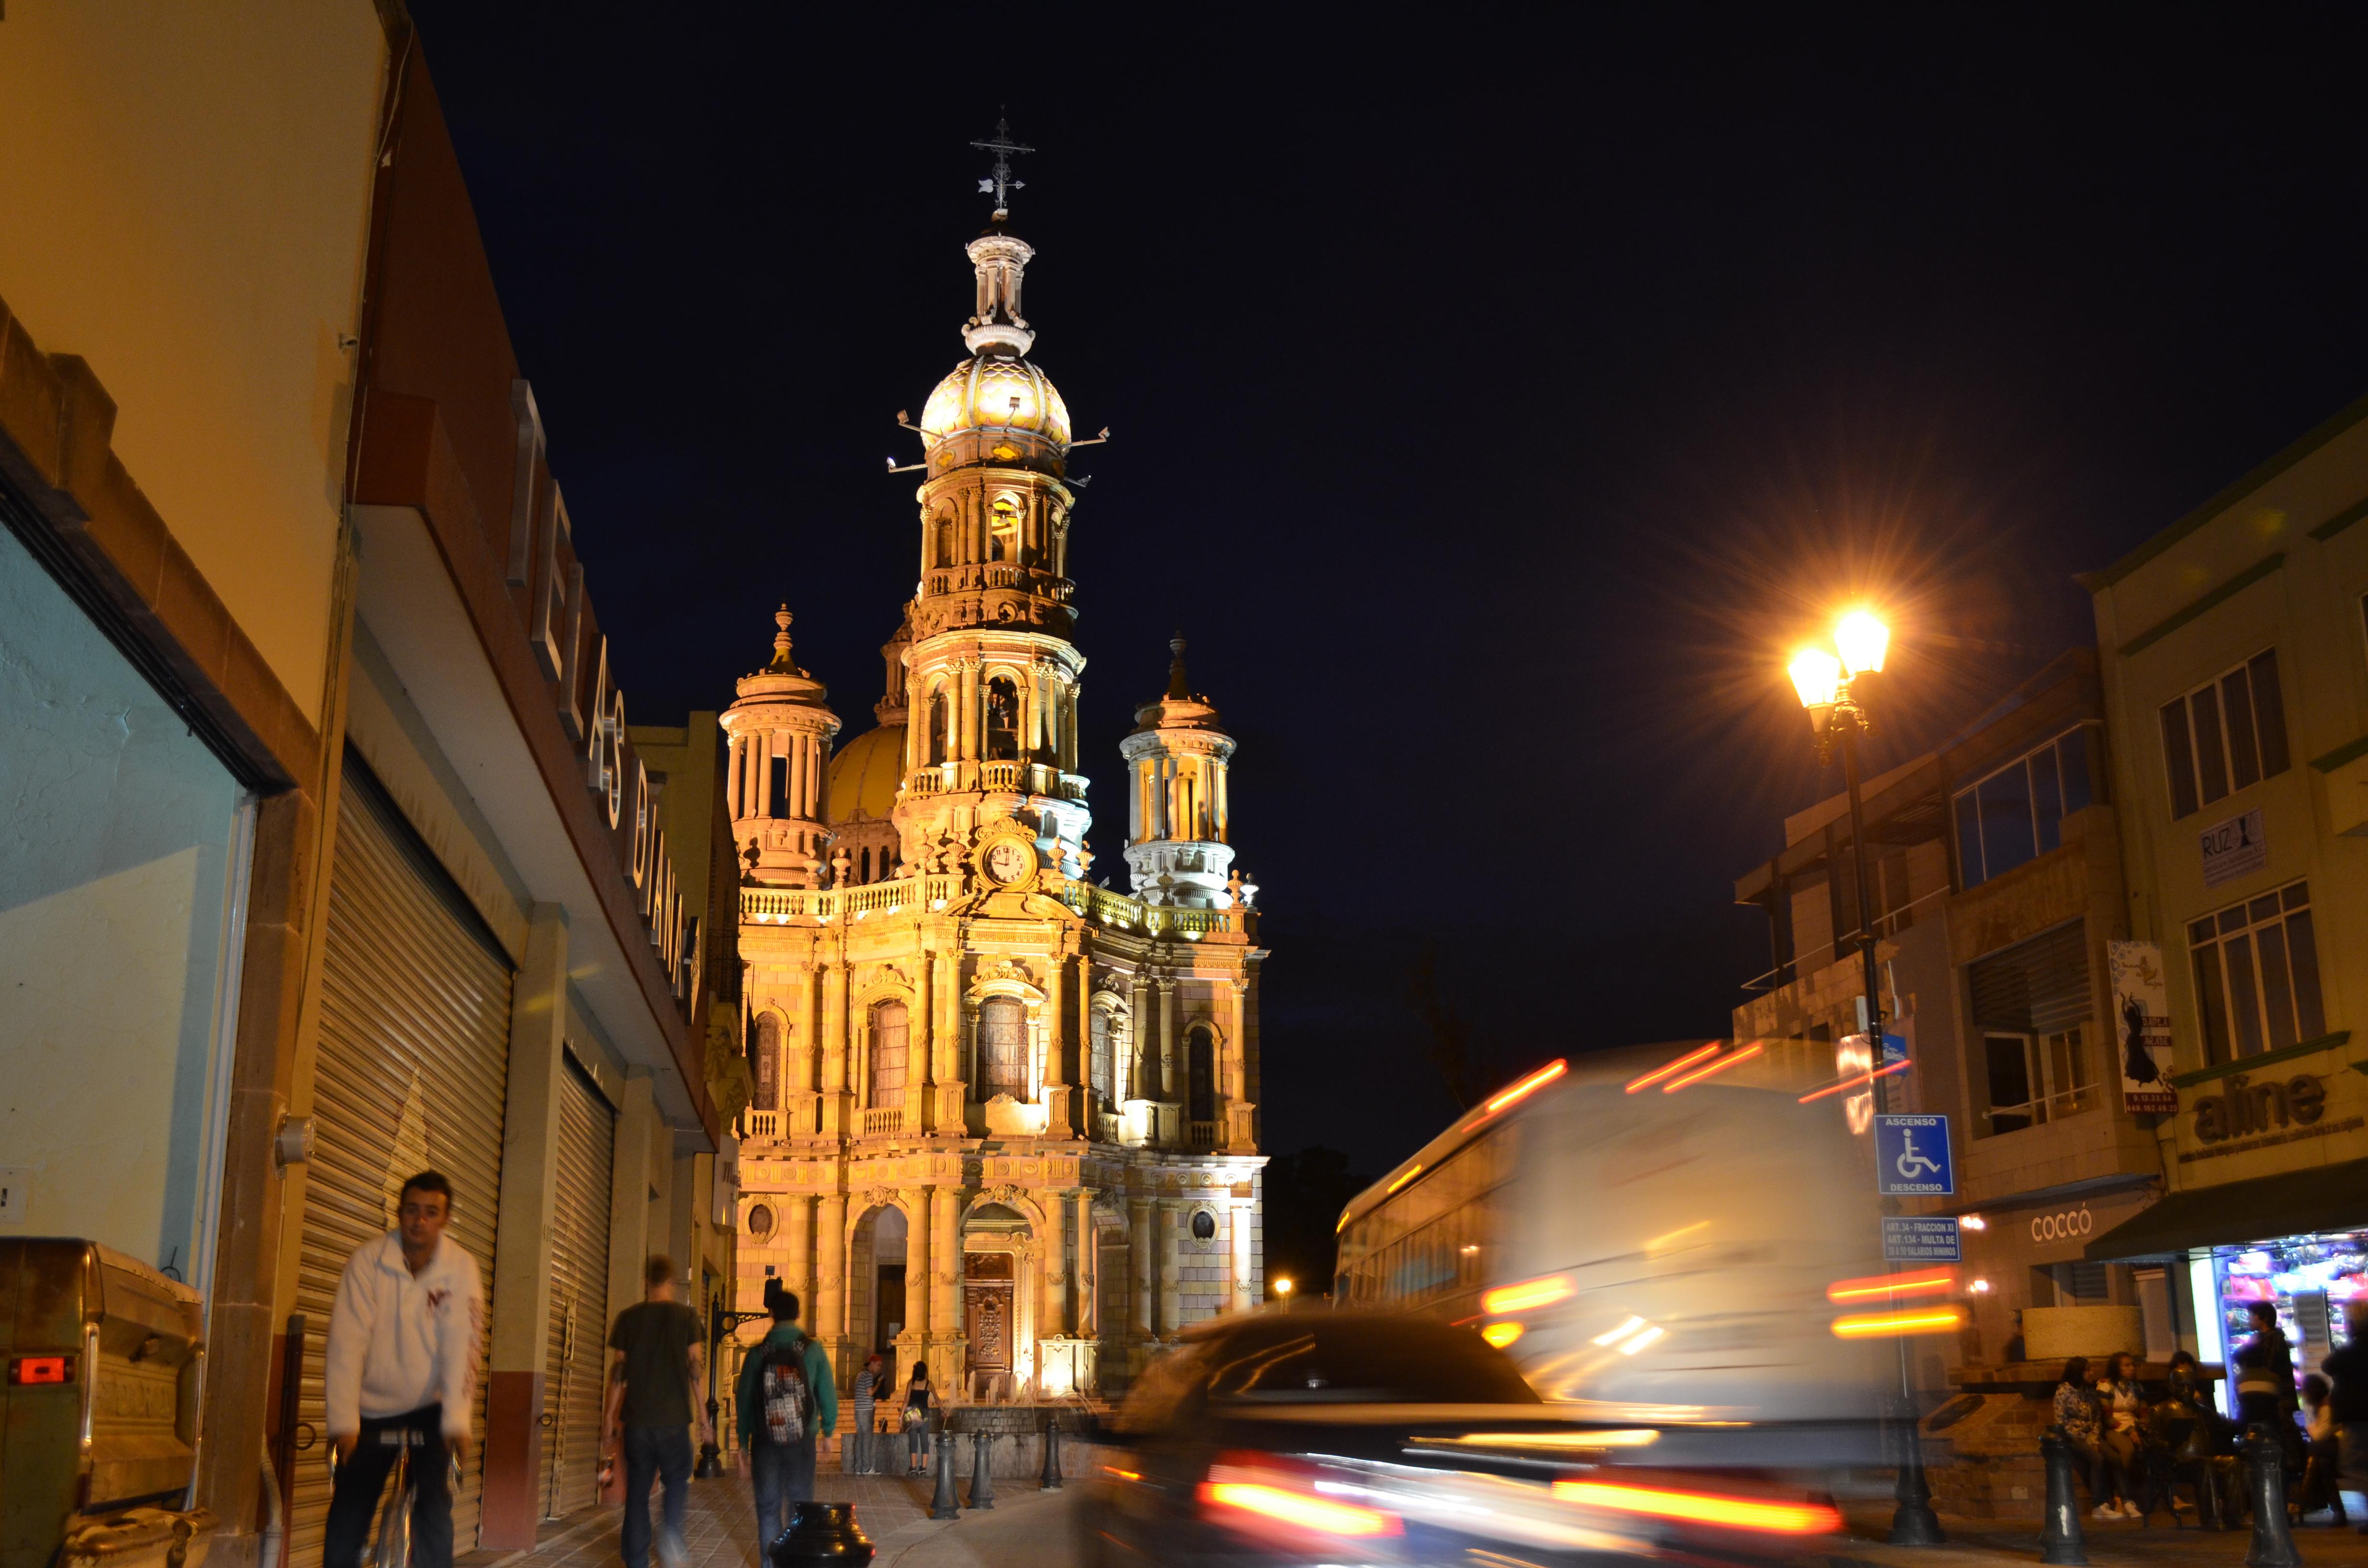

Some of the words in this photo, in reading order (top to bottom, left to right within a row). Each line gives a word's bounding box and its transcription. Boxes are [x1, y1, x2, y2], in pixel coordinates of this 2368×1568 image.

[2202, 828, 2232, 859] RUZ
[2193, 1074, 2326, 1145] aline
[1886, 1118, 1936, 1126] ASCENSO
[2031, 1201, 2092, 1241] COCCÓ
[1914, 1223, 1946, 1232] FRACCION
[1948, 1223, 1954, 1232] XI
[1921, 1235, 1945, 1244] MULTA
[1946, 1235, 1955, 1244] DE
[1895, 1247, 1899, 1255] A
[1907, 1247, 1933, 1256] SALARIOS
[1933, 1247, 1956, 1256] MINIMOS
